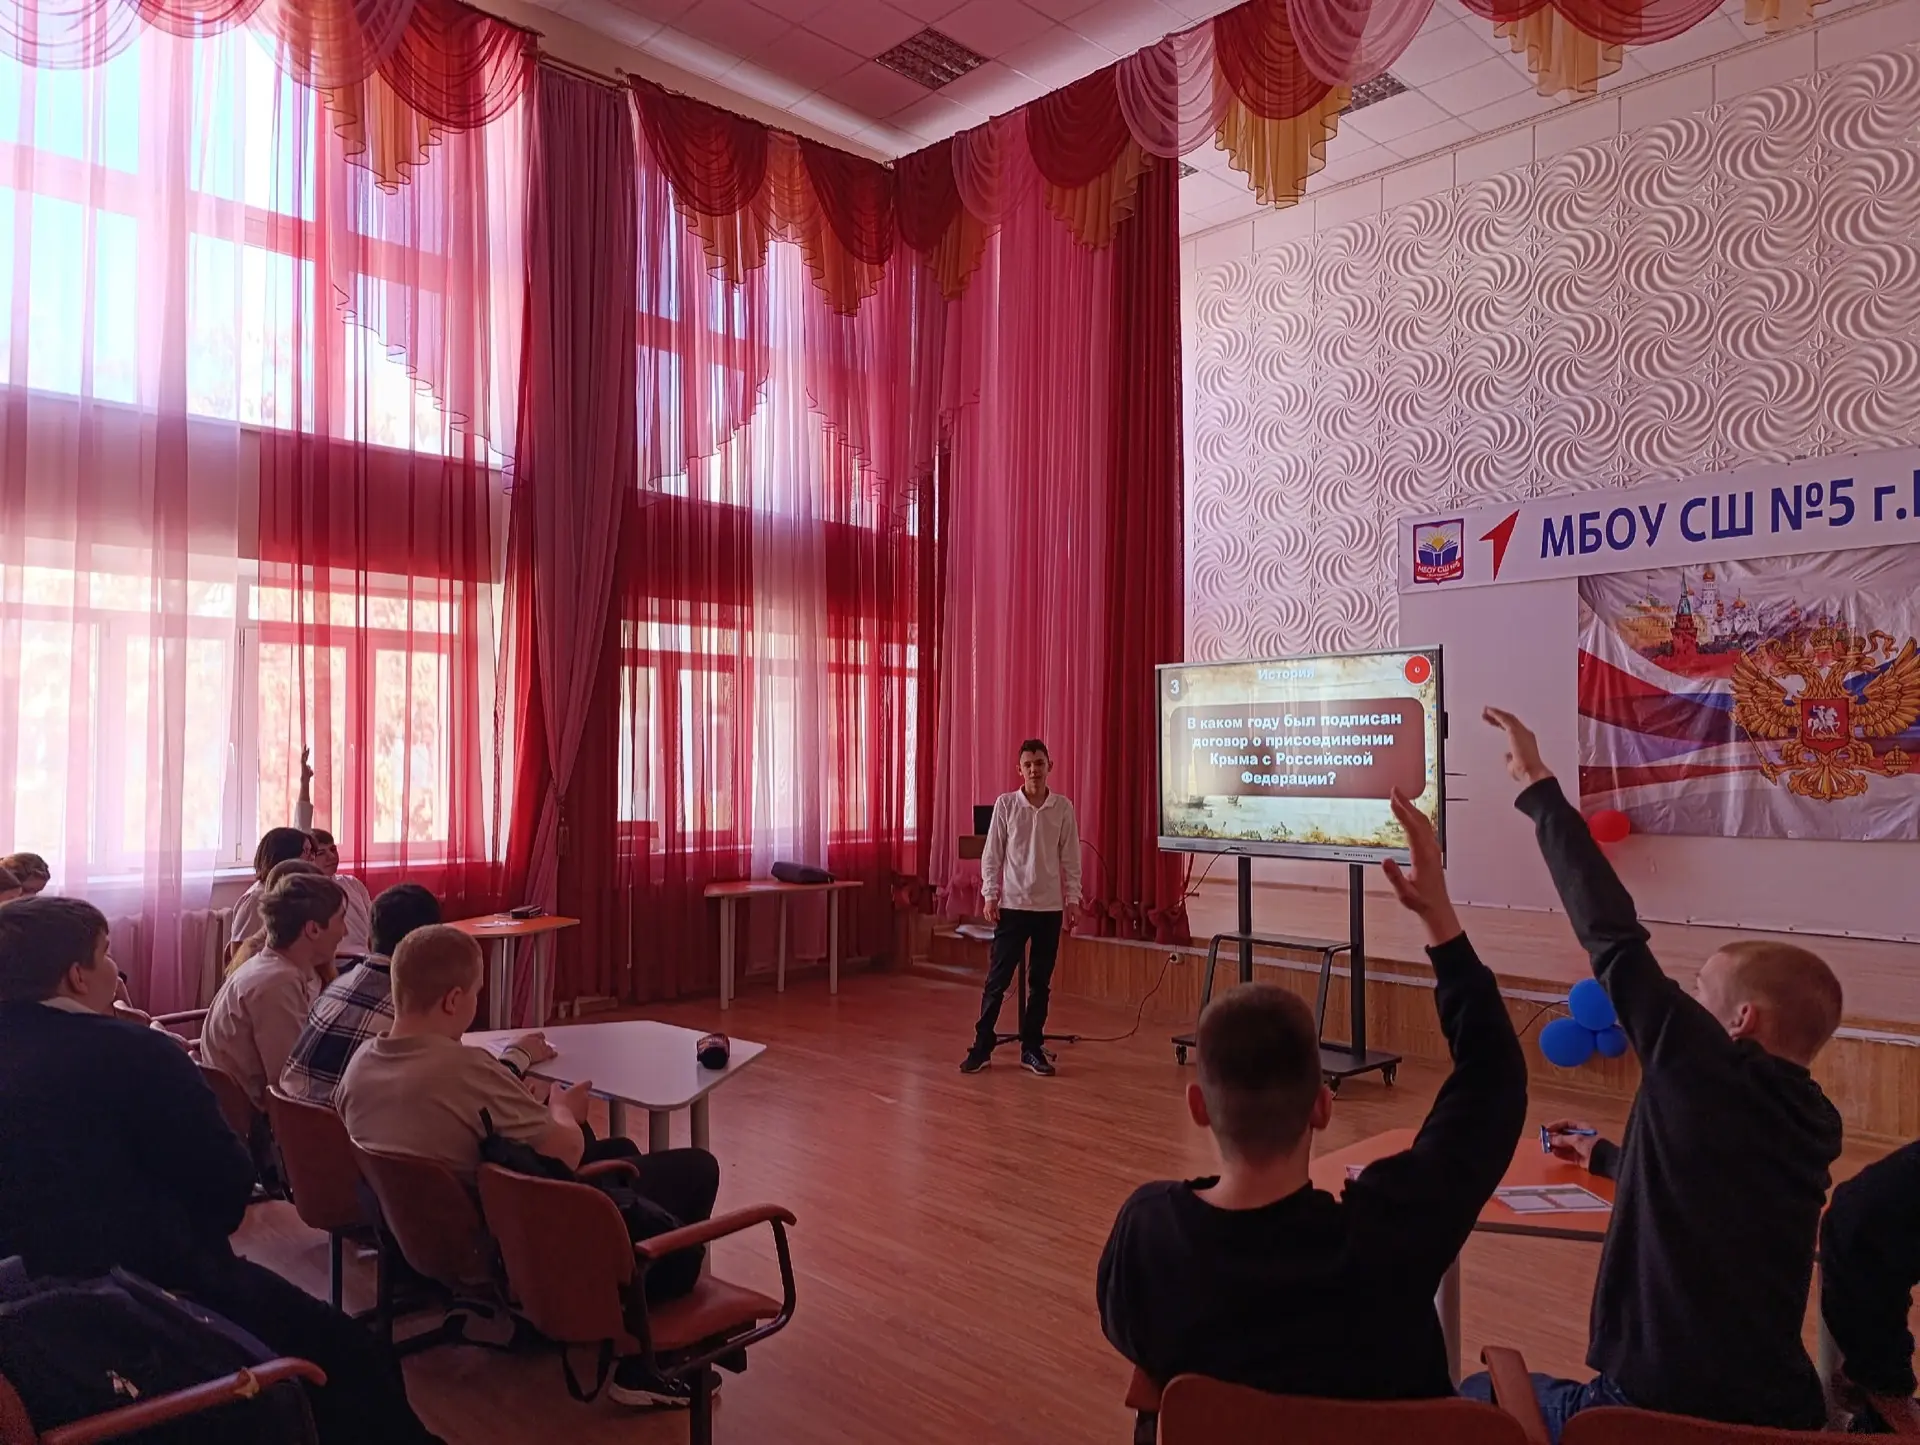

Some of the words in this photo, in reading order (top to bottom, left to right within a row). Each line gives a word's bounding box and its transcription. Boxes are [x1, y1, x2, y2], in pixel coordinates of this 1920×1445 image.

[1540, 503, 1667, 558] МБОУ
[1680, 492, 1753, 542] СШ
[1771, 478, 1855, 533] №5
[1874, 469, 1920, 521] г.
[1170, 680, 1180, 694] 3
[1187, 718, 1196, 729] В
[1200, 717, 1242, 729] каком
[1247, 716, 1279, 730] году
[1283, 714, 1316, 727] был
[1320, 714, 1402, 728] подписан
[1192, 737, 1249, 749] договор
[1252, 739, 1262, 747] о
[1265, 734, 1394, 749] присоединении
[1210, 753, 1258, 768] Крыма
[1262, 757, 1272, 766] с
[1276, 751, 1373, 766] Российской
[1241, 771, 1336, 787] Федерации?
